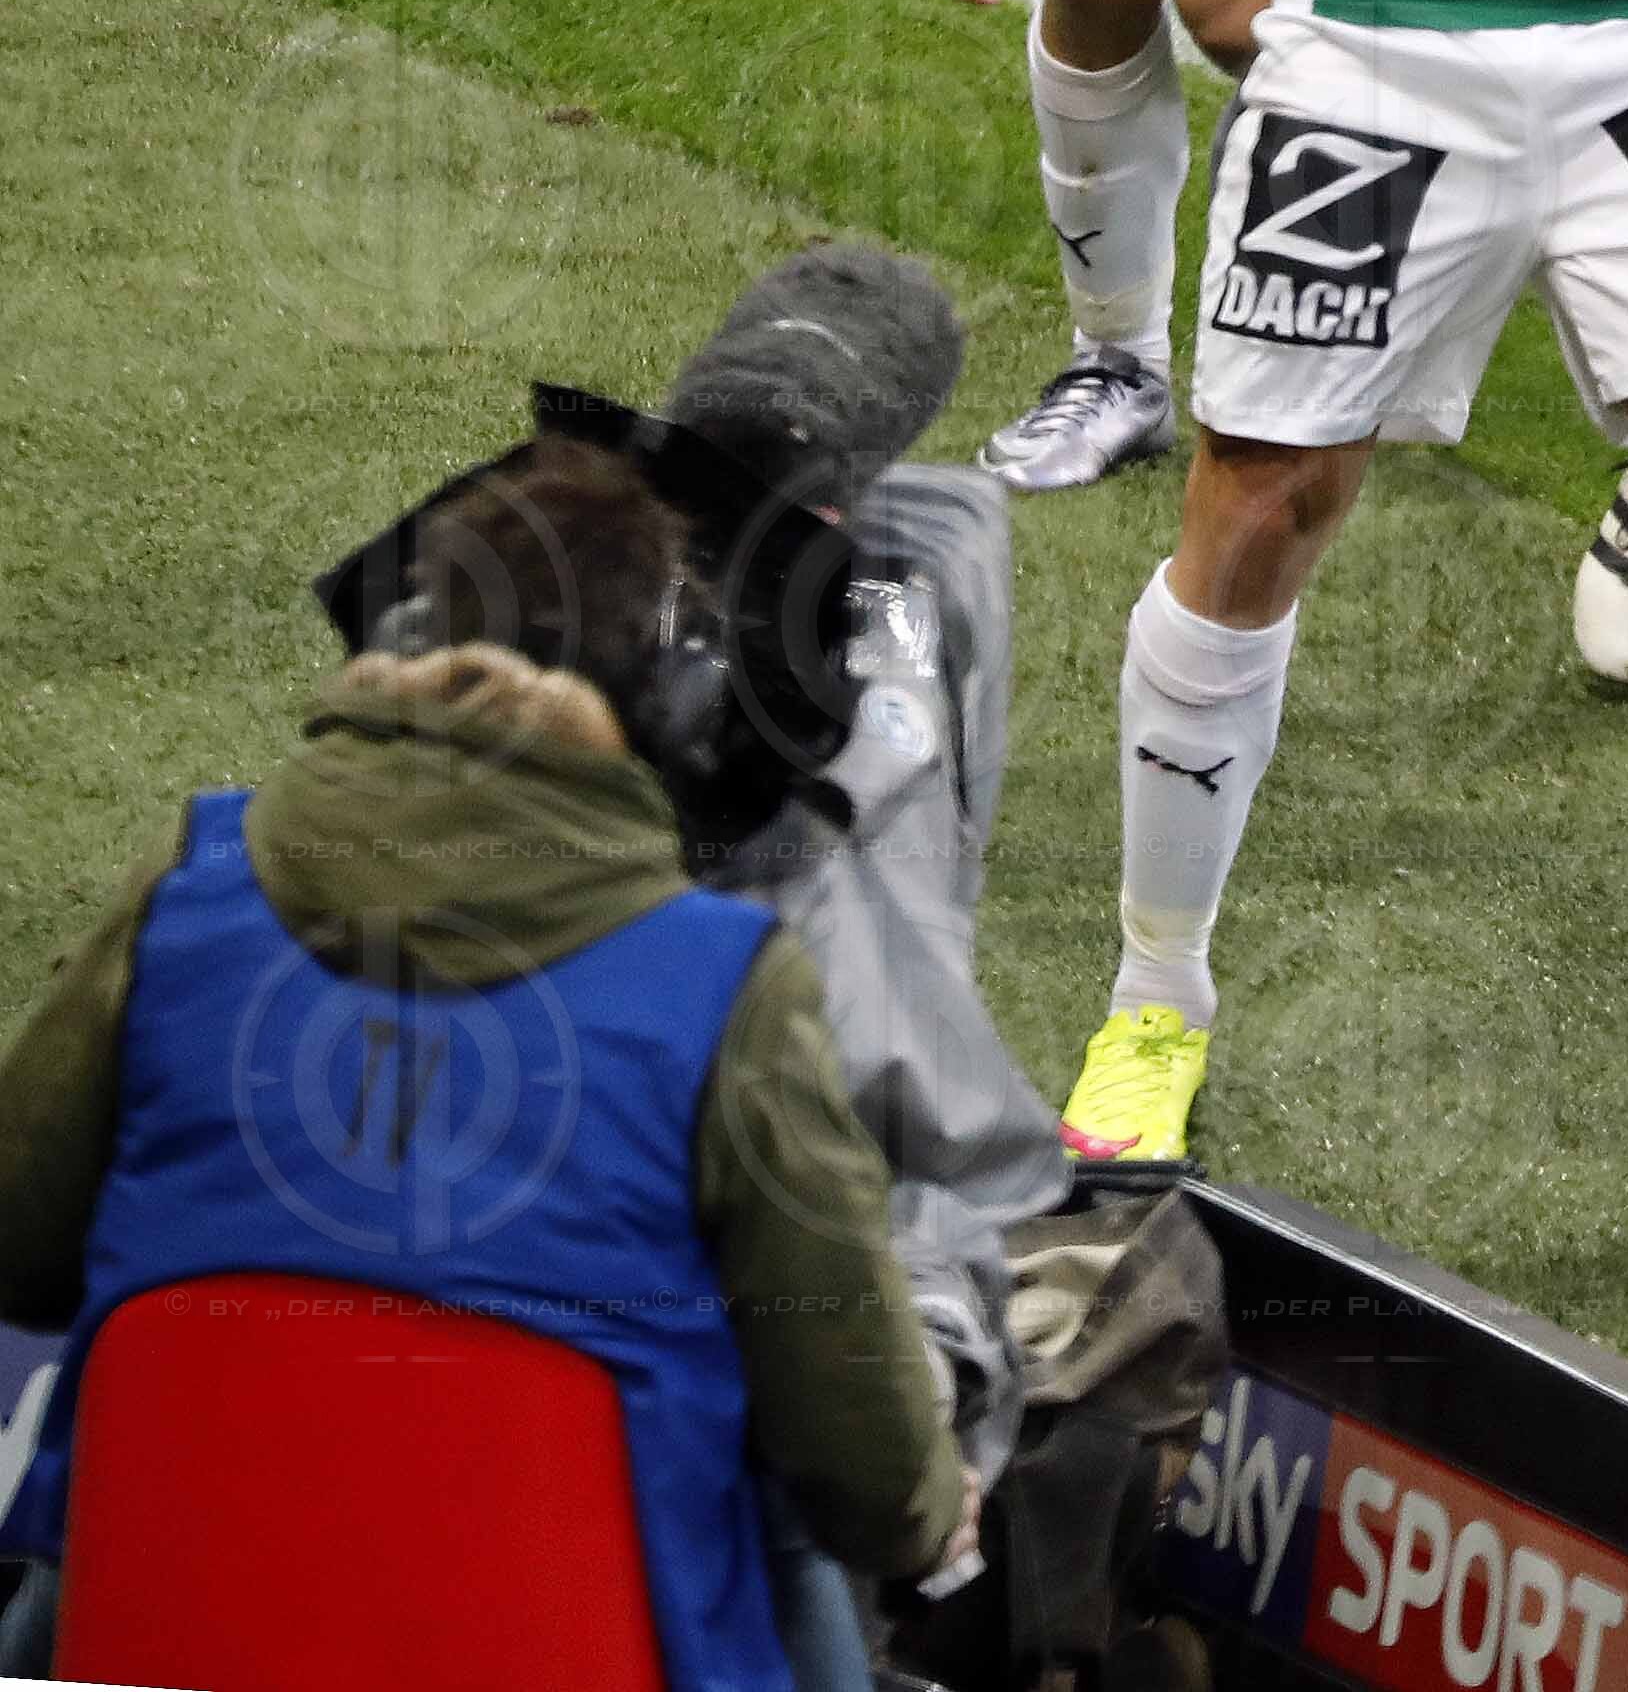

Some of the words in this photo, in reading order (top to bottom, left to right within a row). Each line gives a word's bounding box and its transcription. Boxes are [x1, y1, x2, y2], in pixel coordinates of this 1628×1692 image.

[1215, 264, 1392, 343] DACH
[1176, 1375, 1313, 1616] sky
[1329, 1465, 1626, 1692] SPORT
